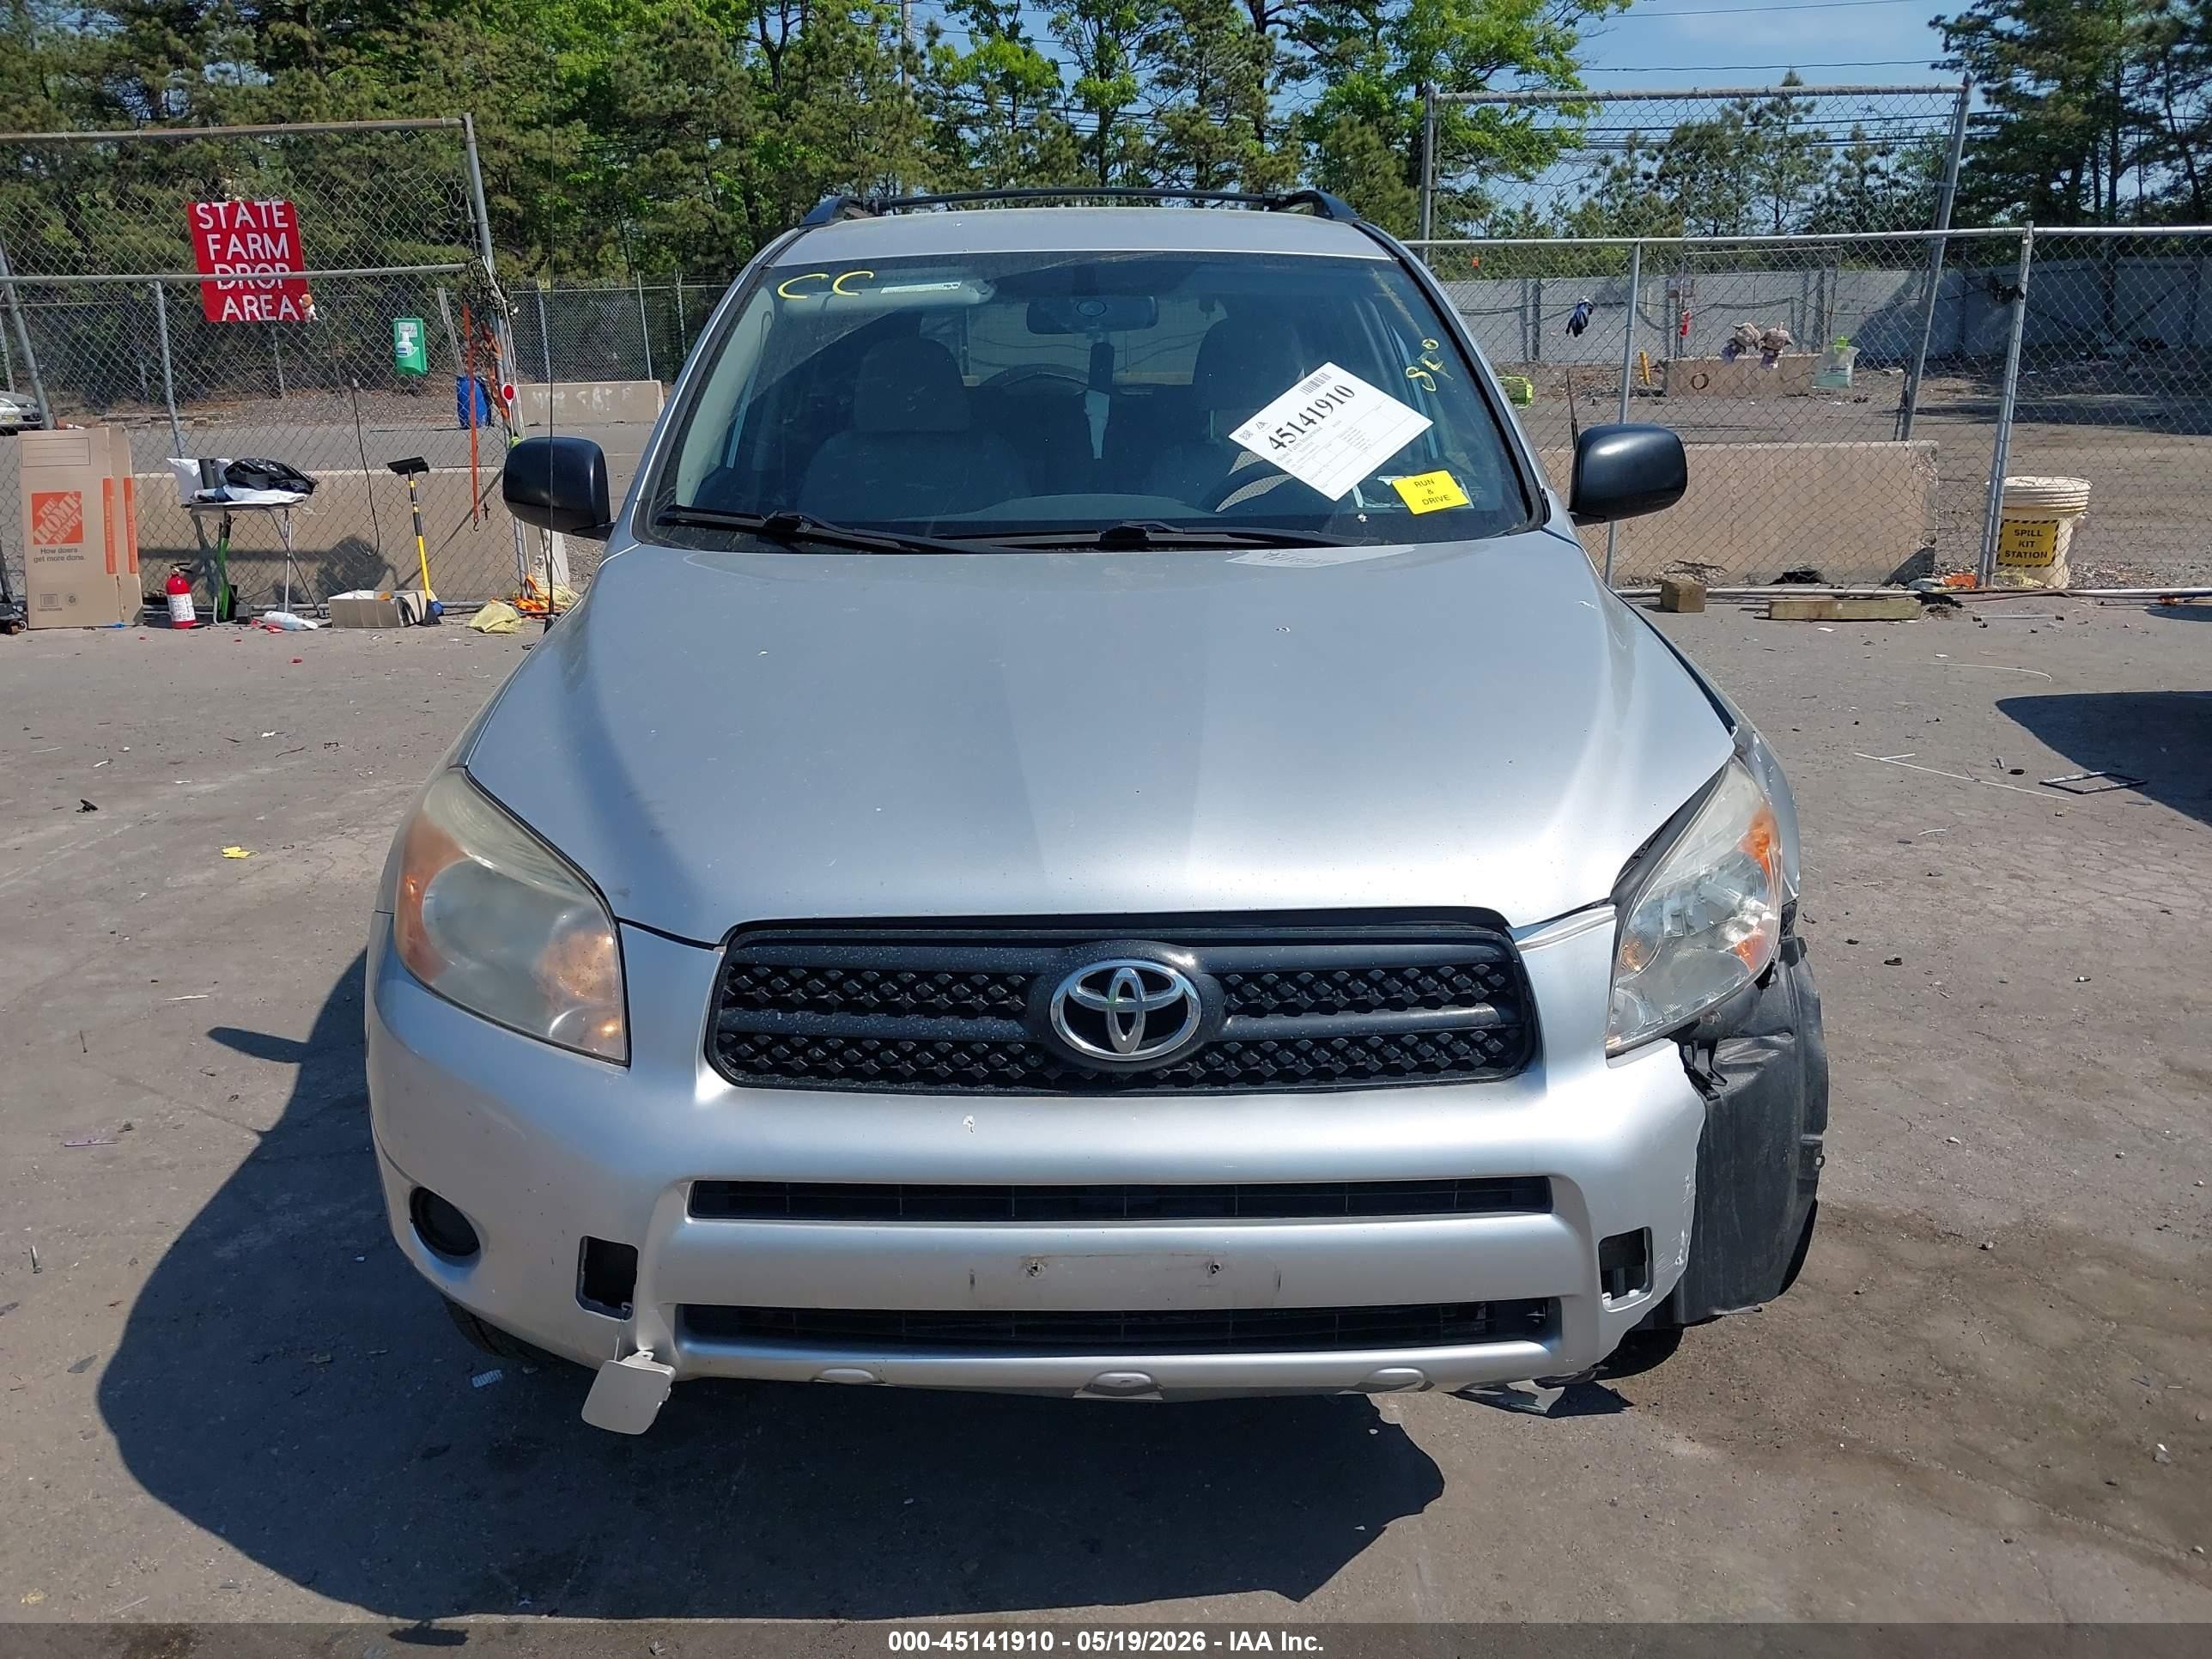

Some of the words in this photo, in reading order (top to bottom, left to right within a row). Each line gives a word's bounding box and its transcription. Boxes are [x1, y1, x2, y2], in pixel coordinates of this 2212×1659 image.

[196, 200, 289, 229] STATE
[206, 233, 289, 260] FARM
[215, 263, 290, 290] DROP
[222, 295, 300, 321] AREA
[1267, 385, 1356, 451] 45141910
[1413, 478, 1435, 488] RUN
[1422, 495, 1451, 505] DRIVE
[33, 492, 82, 544] HOME
[52, 507, 82, 544] DEPOT
